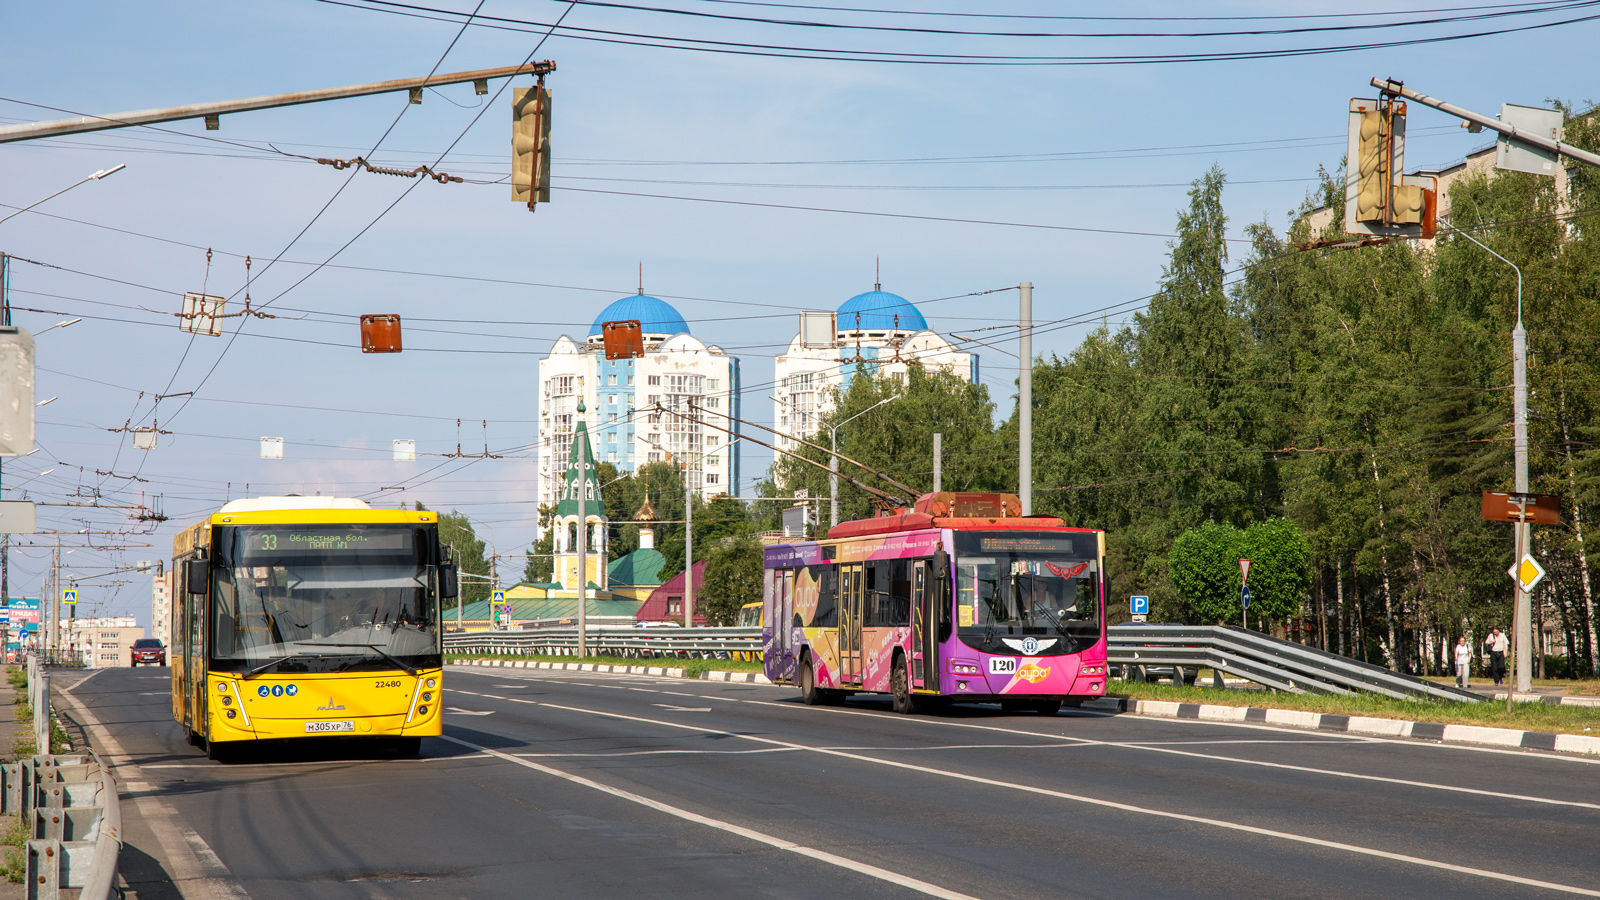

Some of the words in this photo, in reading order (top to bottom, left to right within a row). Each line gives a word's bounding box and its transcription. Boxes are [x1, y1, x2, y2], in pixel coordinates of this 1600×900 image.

[262, 534, 277, 550] 33
[290, 534, 340, 542] Областная
[346, 533, 368, 542] бол.
[309, 541, 333, 549] ПАТП
[1135, 598, 1146, 612] P
[992, 660, 1015, 671] 120
[1019, 669, 1047, 680] аура
[375, 680, 402, 688] 22480
[343, 721, 352, 729] 76
